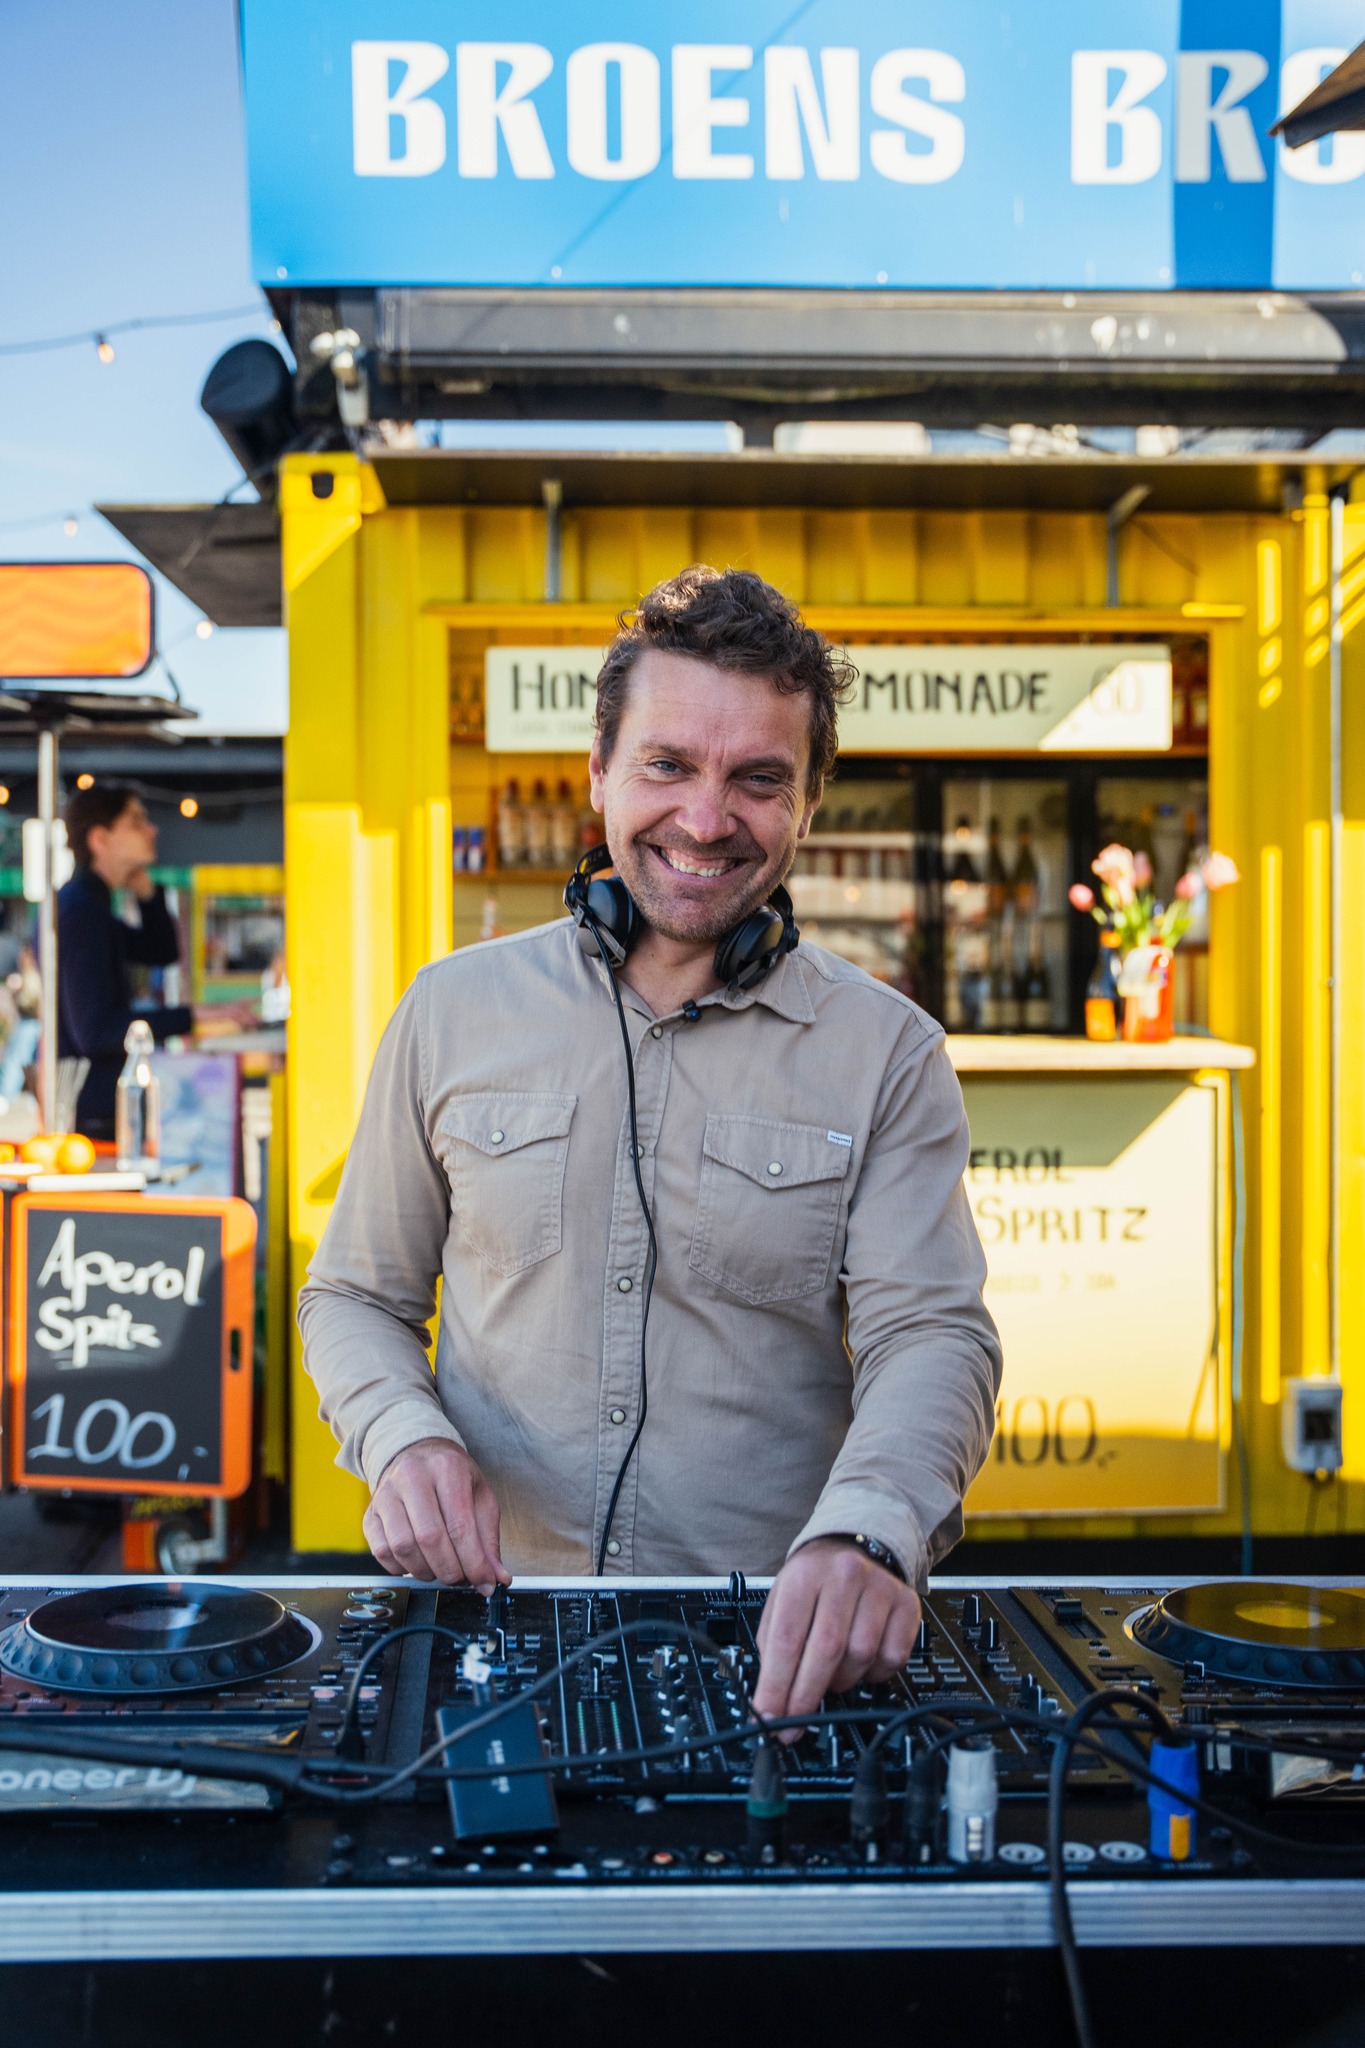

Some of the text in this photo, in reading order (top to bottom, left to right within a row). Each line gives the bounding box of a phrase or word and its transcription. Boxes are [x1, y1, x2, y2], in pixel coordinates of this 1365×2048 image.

[352, 40, 966, 184] BROENS
[849, 671, 1052, 716] MONADE
[37, 1218, 206, 1312] Aperol
